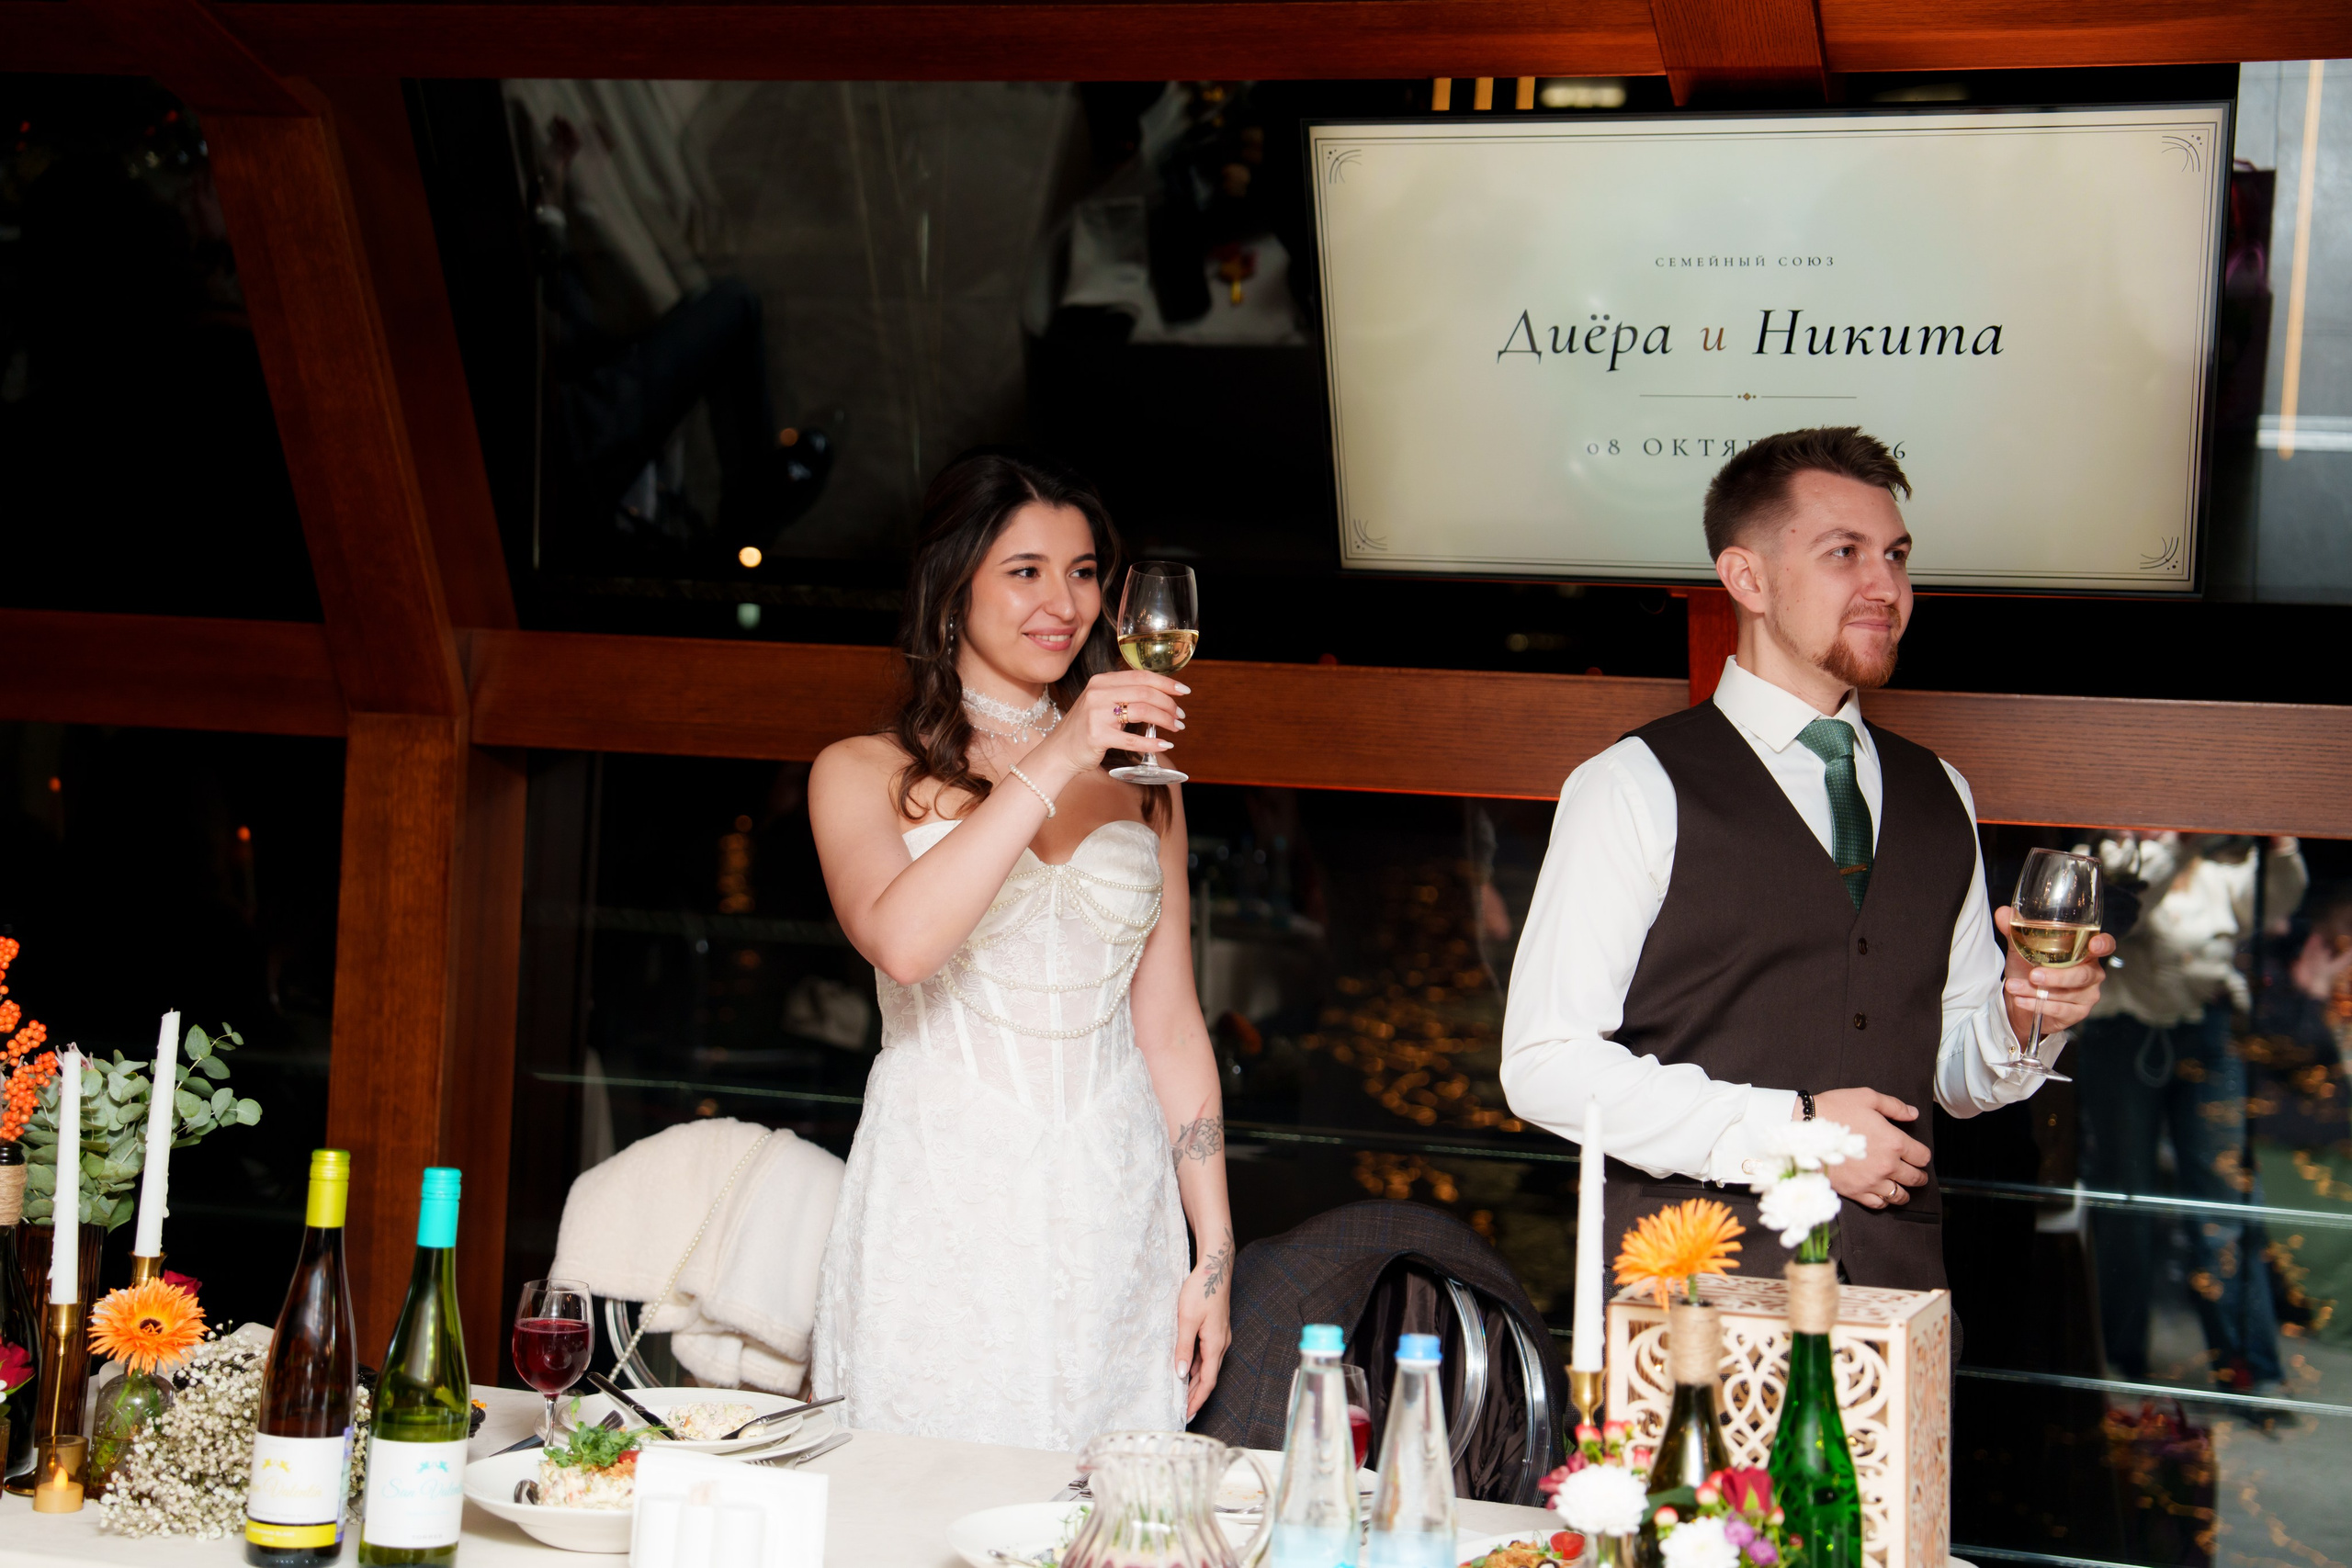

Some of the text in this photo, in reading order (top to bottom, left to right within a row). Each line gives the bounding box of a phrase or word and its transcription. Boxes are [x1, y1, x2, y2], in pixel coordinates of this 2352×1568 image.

[1655, 254, 1835, 268] СЕМЕЙНЫЙ СОЮЗ
[1497, 309, 2005, 372] Диёра и Никита
[1643, 436, 1759, 457] ОКТЯ
